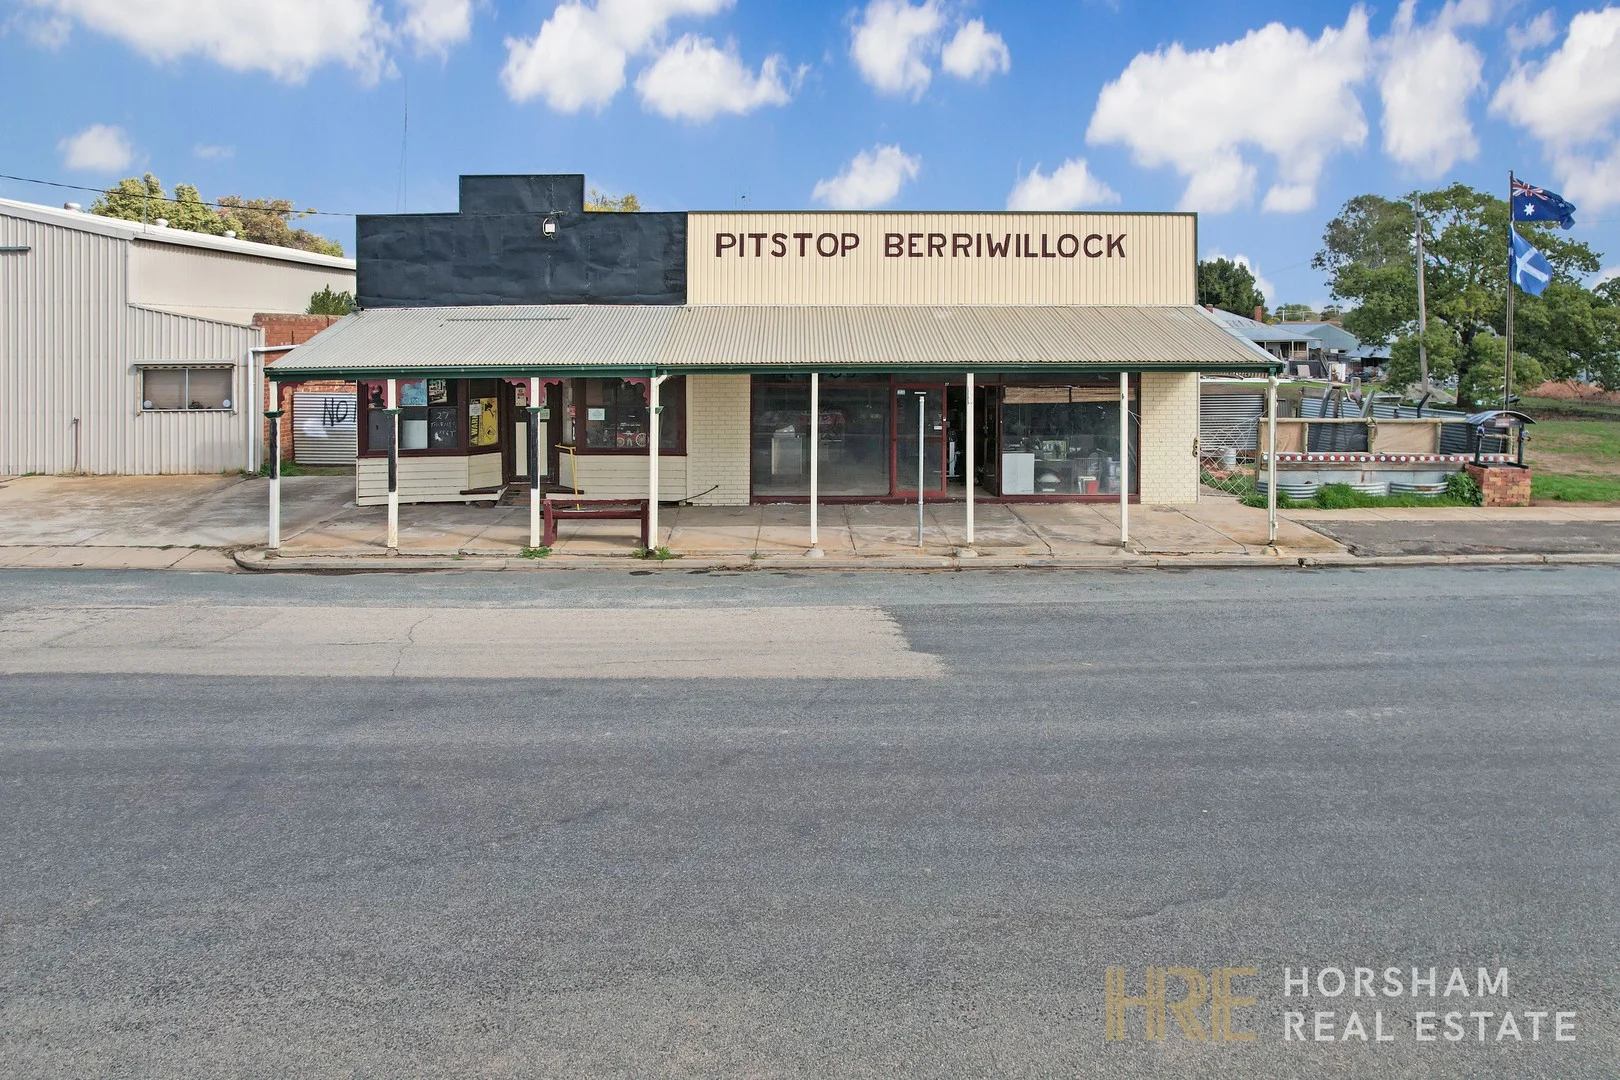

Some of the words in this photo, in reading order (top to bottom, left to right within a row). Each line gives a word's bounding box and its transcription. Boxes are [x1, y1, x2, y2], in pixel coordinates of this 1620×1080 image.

[716, 232, 860, 258] PITSTOP
[884, 232, 1127, 258] BERRIWILLOCK
[436, 411, 449, 420] 27
